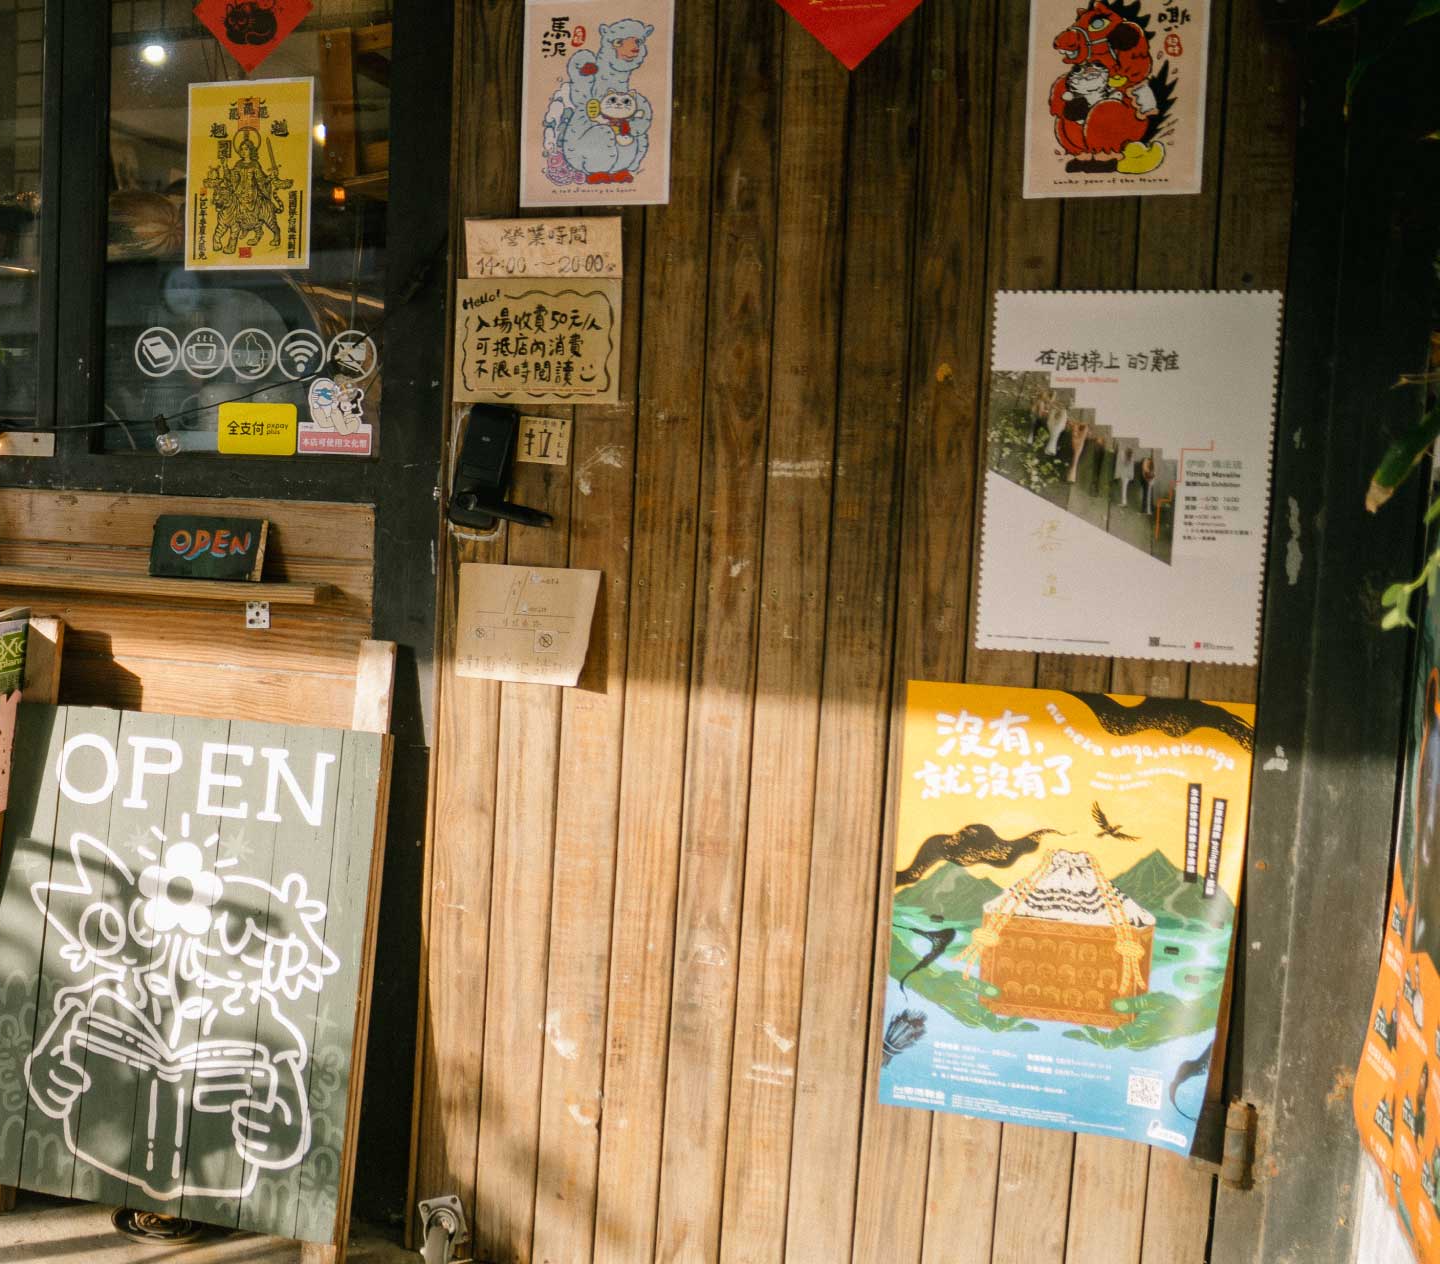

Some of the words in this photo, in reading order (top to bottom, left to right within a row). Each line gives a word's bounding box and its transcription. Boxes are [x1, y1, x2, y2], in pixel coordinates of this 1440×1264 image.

[501, 224, 588, 246] 營業時間
[475, 333, 584, 358] 可抵店內消費
[475, 360, 574, 386] 不限時閱讀
[227, 420, 264, 436] 全支付
[523, 428, 553, 458] 拉
[170, 529, 252, 560] OPEN
[56, 732, 336, 827] OPEN
[912, 754, 1073, 800] 就沒有了
